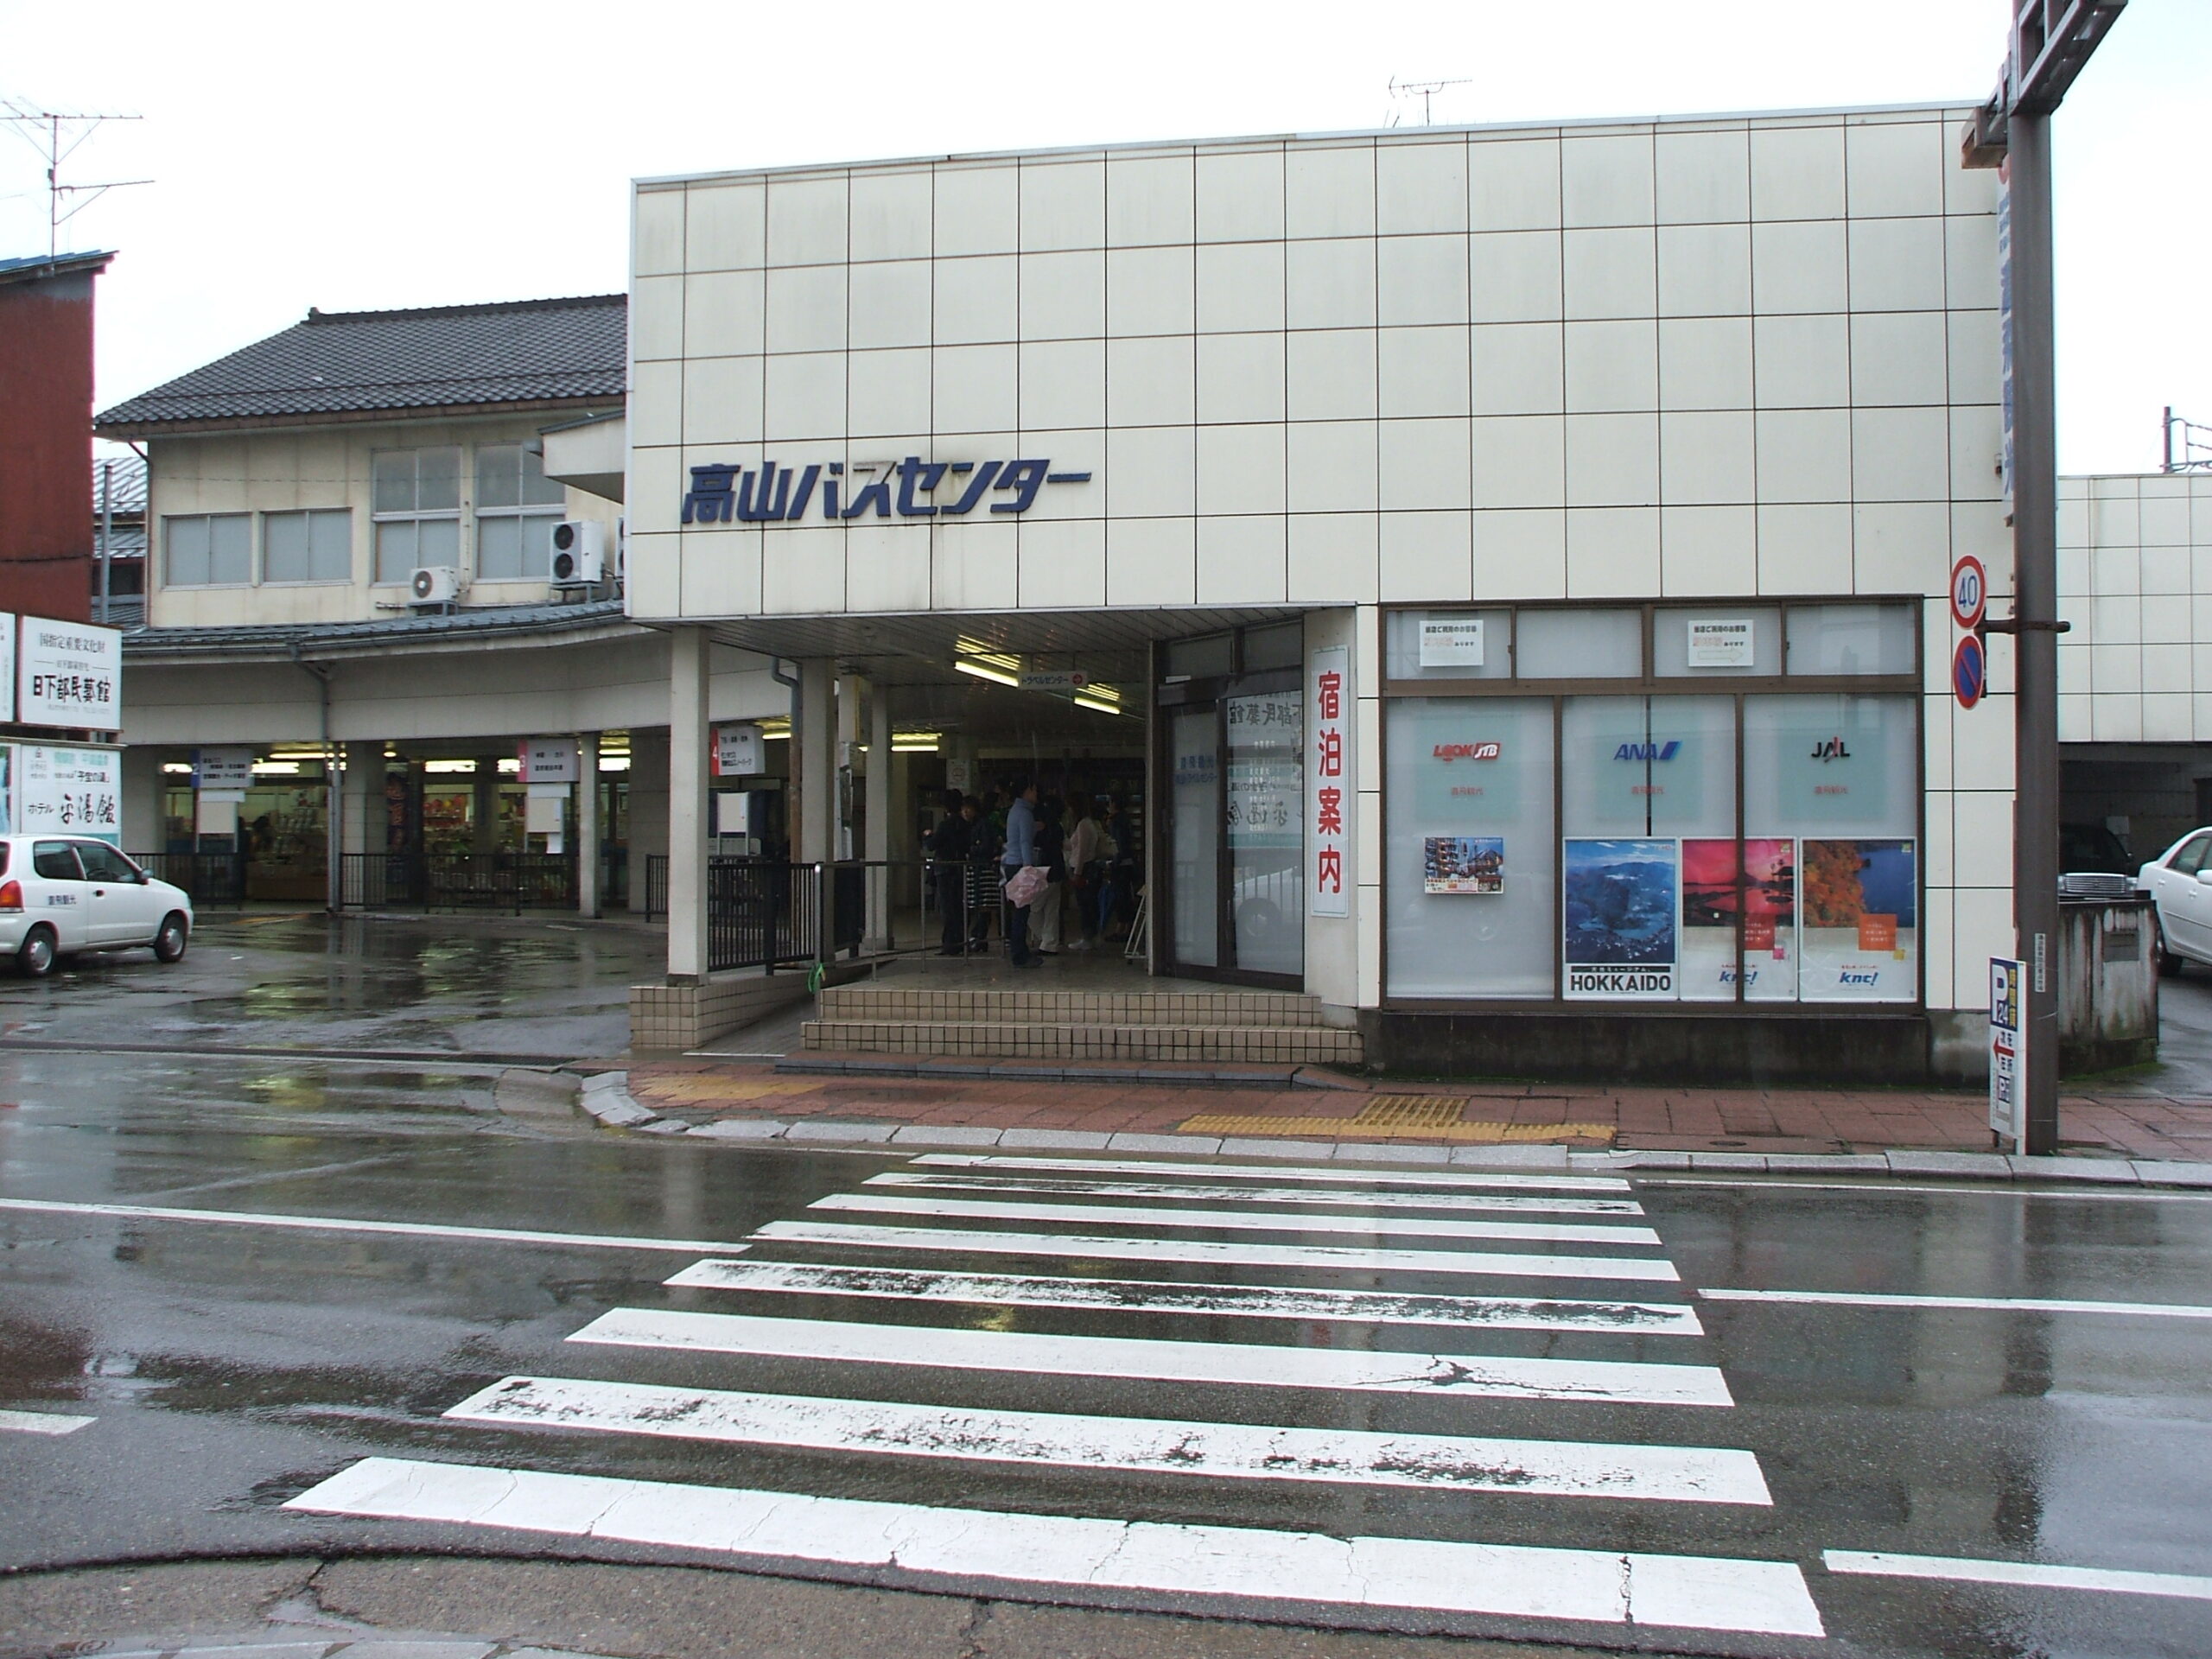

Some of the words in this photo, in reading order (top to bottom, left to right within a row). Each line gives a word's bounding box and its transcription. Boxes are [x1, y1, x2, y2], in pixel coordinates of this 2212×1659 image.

[680, 457, 1091, 524] 高山バスセンター
[1958, 575, 1977, 607] 40
[712, 746, 718, 760] 4
[1433, 745, 1472, 761] LOOK
[1473, 743, 1500, 760] JTB
[1613, 744, 1657, 760] ANA
[1811, 737, 1850, 762] JAL
[193, 763, 200, 775] 2
[1318, 670, 1342, 893] 宿泊案内
[29, 803, 54, 815] ホテル
[1570, 975, 1671, 991] HOKKAIDO
[1992, 963, 2009, 1022] P
[1998, 1003, 2008, 1025] 24
